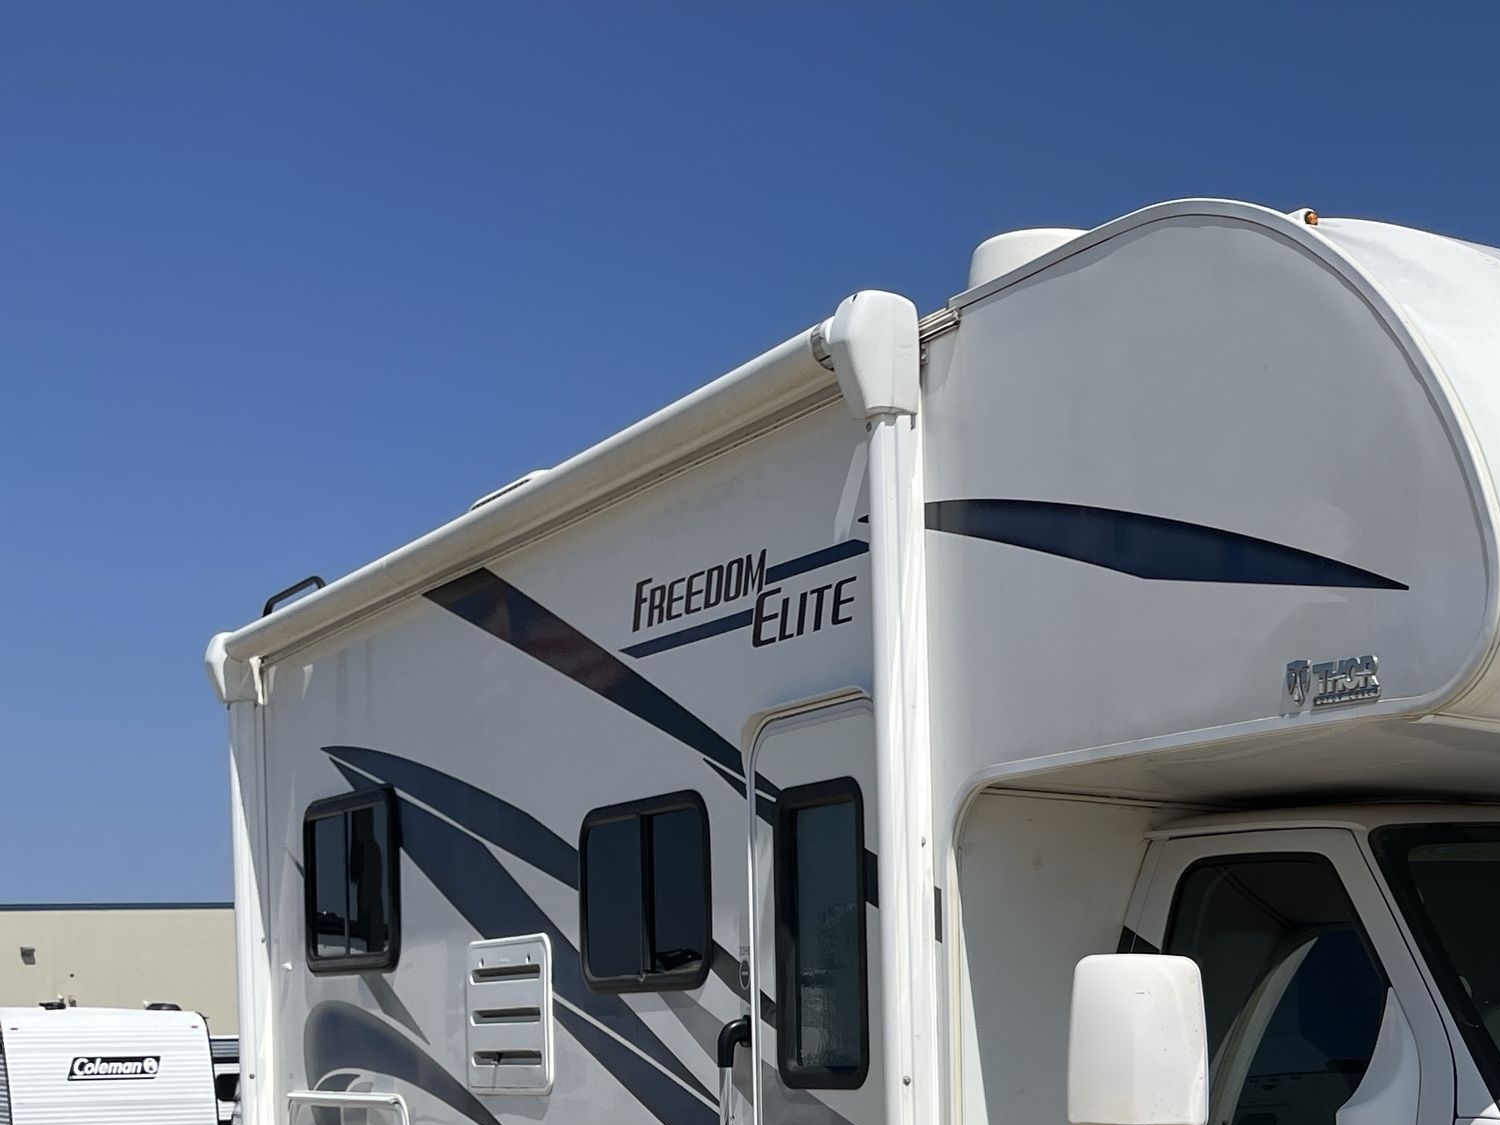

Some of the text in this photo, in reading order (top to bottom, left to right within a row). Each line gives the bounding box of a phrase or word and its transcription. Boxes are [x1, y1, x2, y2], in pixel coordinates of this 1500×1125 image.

[632, 549, 767, 633] FREEDOM
[752, 576, 857, 648] ELITE
[73, 1057, 142, 1076] Coleman
